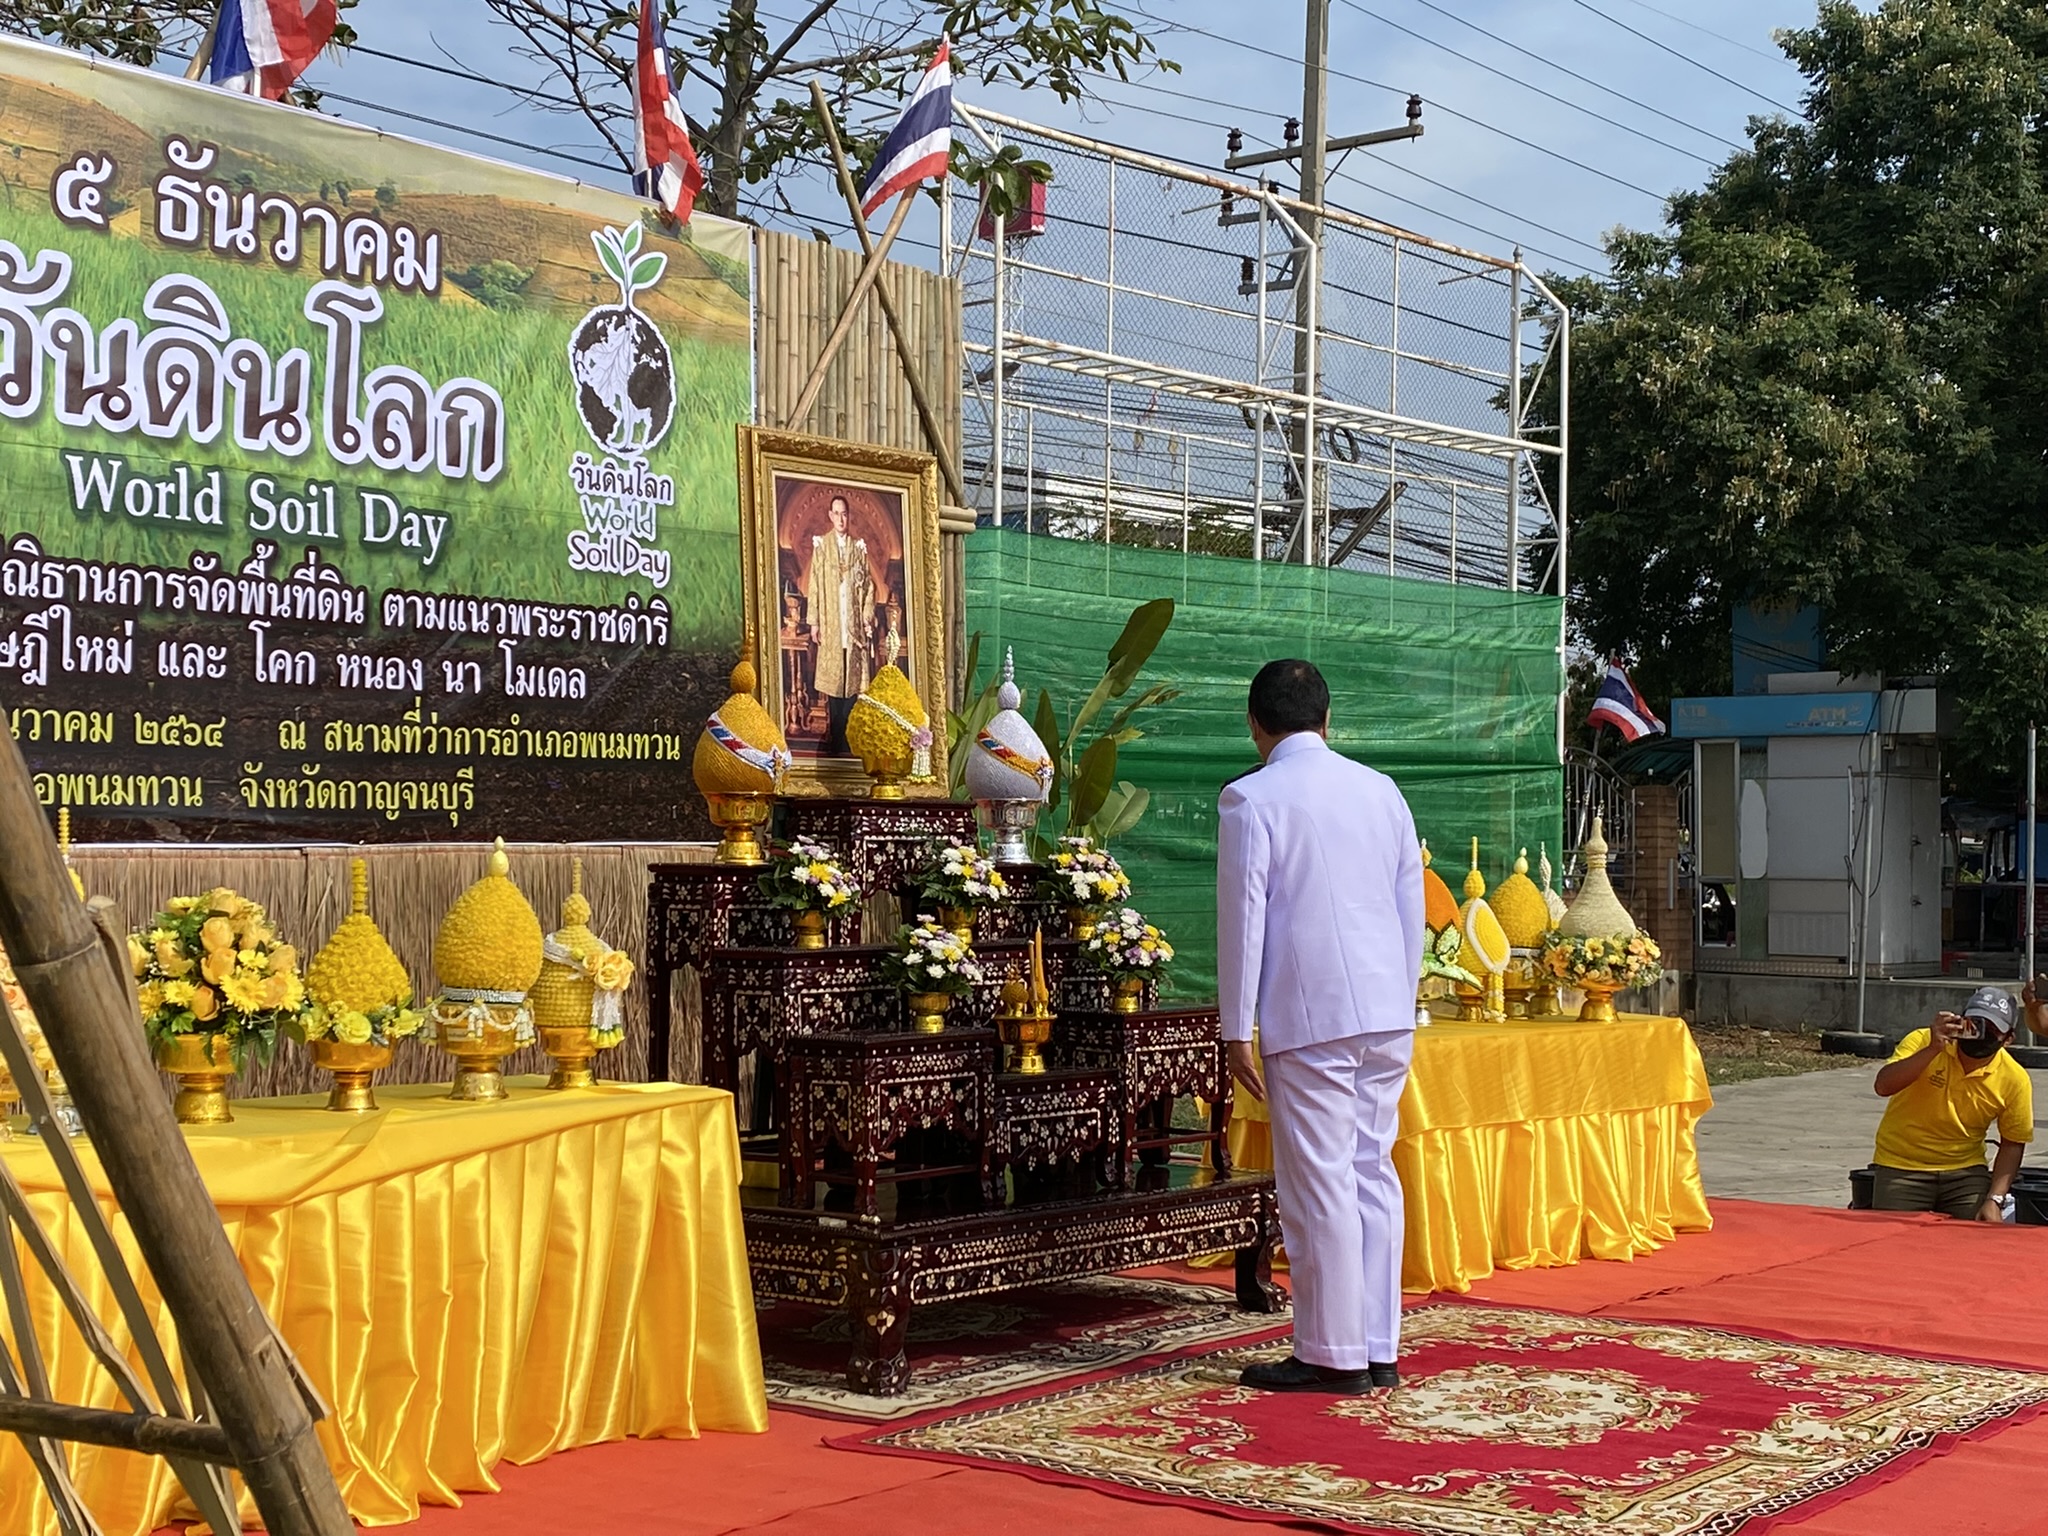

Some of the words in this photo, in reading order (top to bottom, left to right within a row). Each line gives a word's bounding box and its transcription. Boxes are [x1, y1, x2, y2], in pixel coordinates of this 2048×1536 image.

[54, 153, 115, 227] ๕
[154, 136, 441, 294] ธันวาคม
[0, 246, 500, 477] วันดินโลก
[65, 453, 223, 526] World
[249, 478, 339, 539] Soil
[359, 491, 448, 565] Day
[571, 455, 673, 503] วันดินโลก
[582, 498, 654, 537] World
[382, 592, 670, 646] ตามแนวพระราชดำริ
[157, 640, 227, 679] และ
[248, 620, 316, 686] โคก
[336, 652, 423, 691] หนอง
[441, 659, 481, 694] นา
[498, 639, 587, 699] โมเดล
[134, 711, 226, 748] ๒๕๖๔
[278, 719, 306, 751] ณ
[323, 696, 681, 761] สนามที่ว่าการอำเภอพนมทวน
[1807, 707, 1847, 721] ATM
[239, 760, 475, 828] จังหวัดกาญจนบุรี
